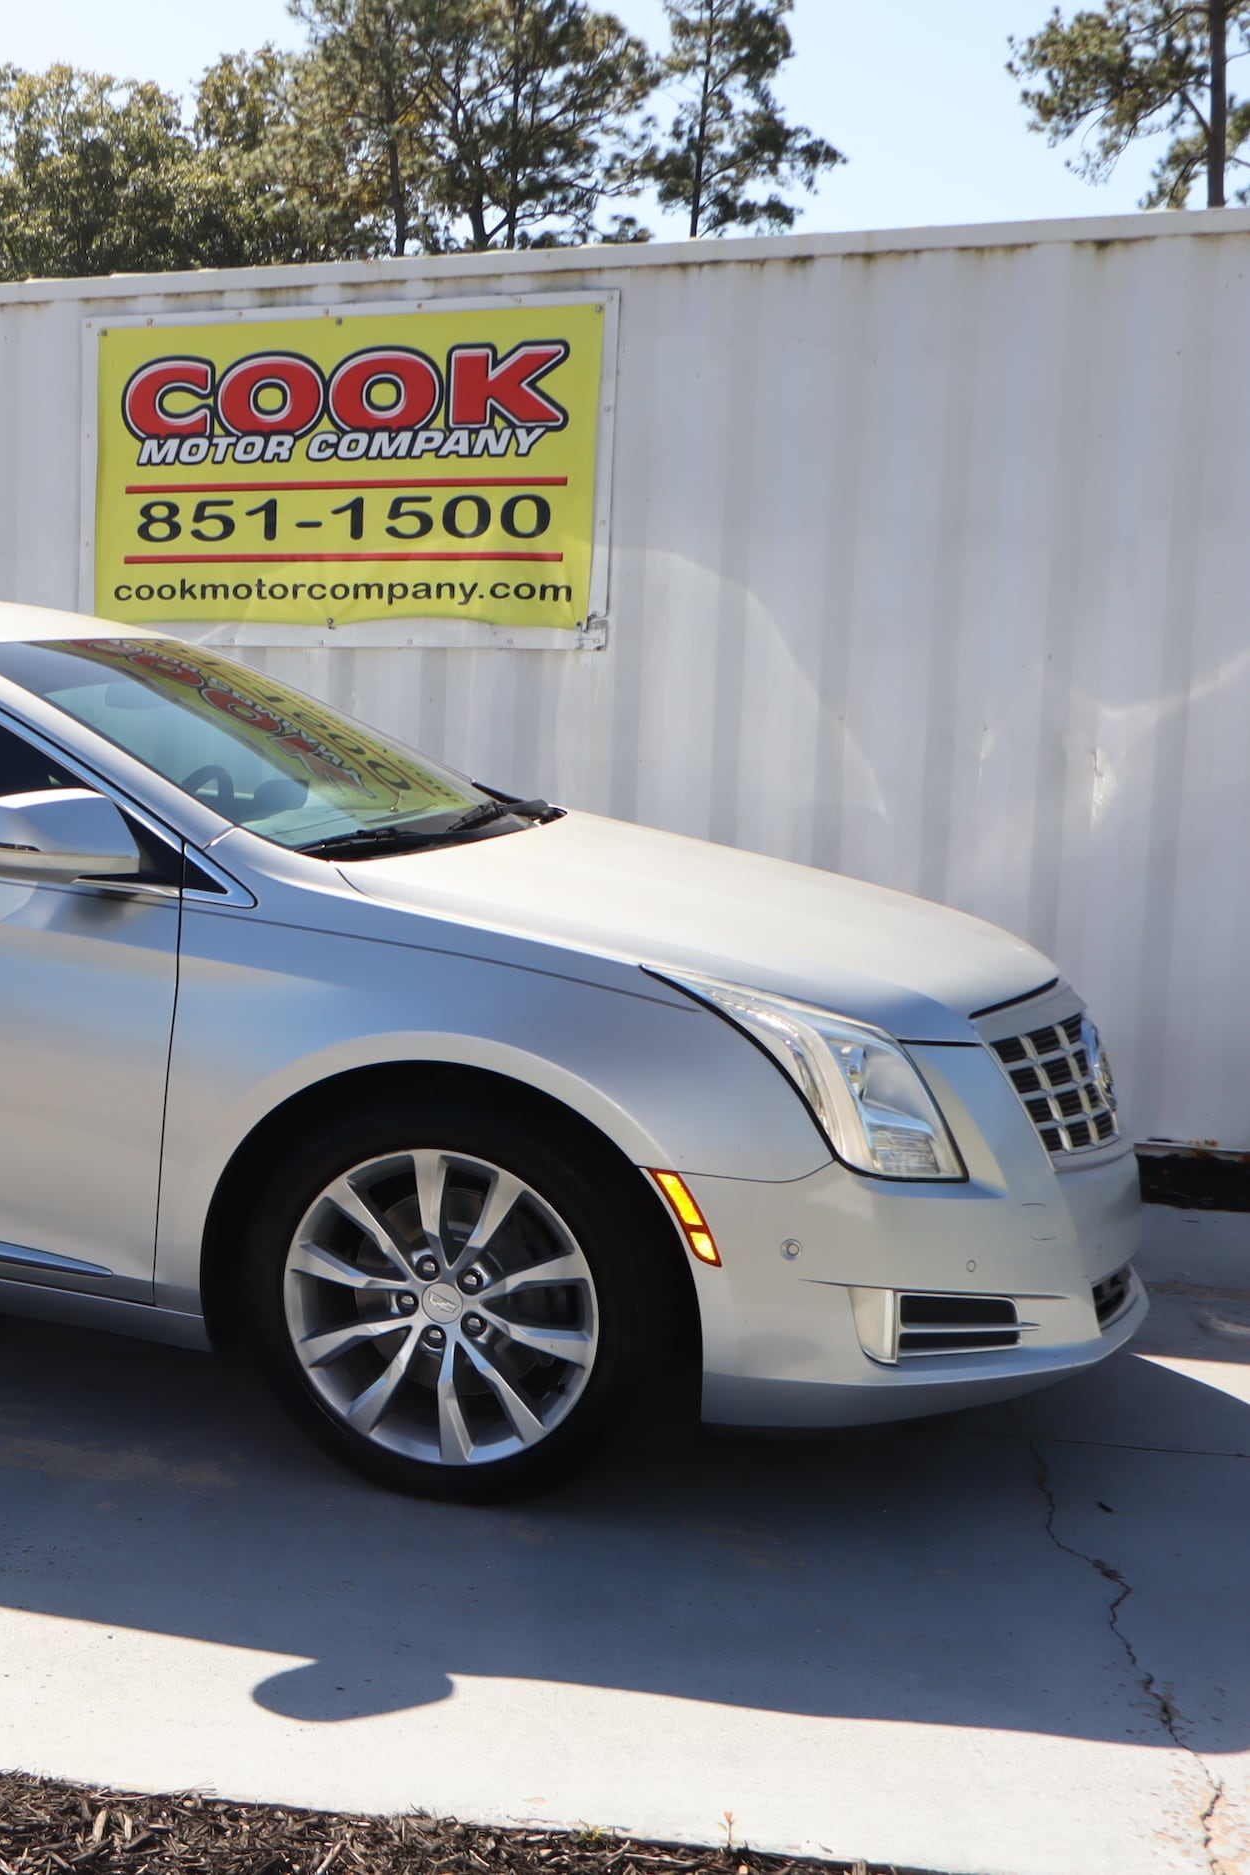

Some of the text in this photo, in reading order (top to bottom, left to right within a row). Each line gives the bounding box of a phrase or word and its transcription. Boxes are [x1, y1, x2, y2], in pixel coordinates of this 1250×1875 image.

[121, 339, 571, 441] COOK
[137, 425, 549, 467] MOTOR COMPANY
[136, 494, 551, 543] 851-1500
[113, 578, 573, 606] cookmotorcompany.com
